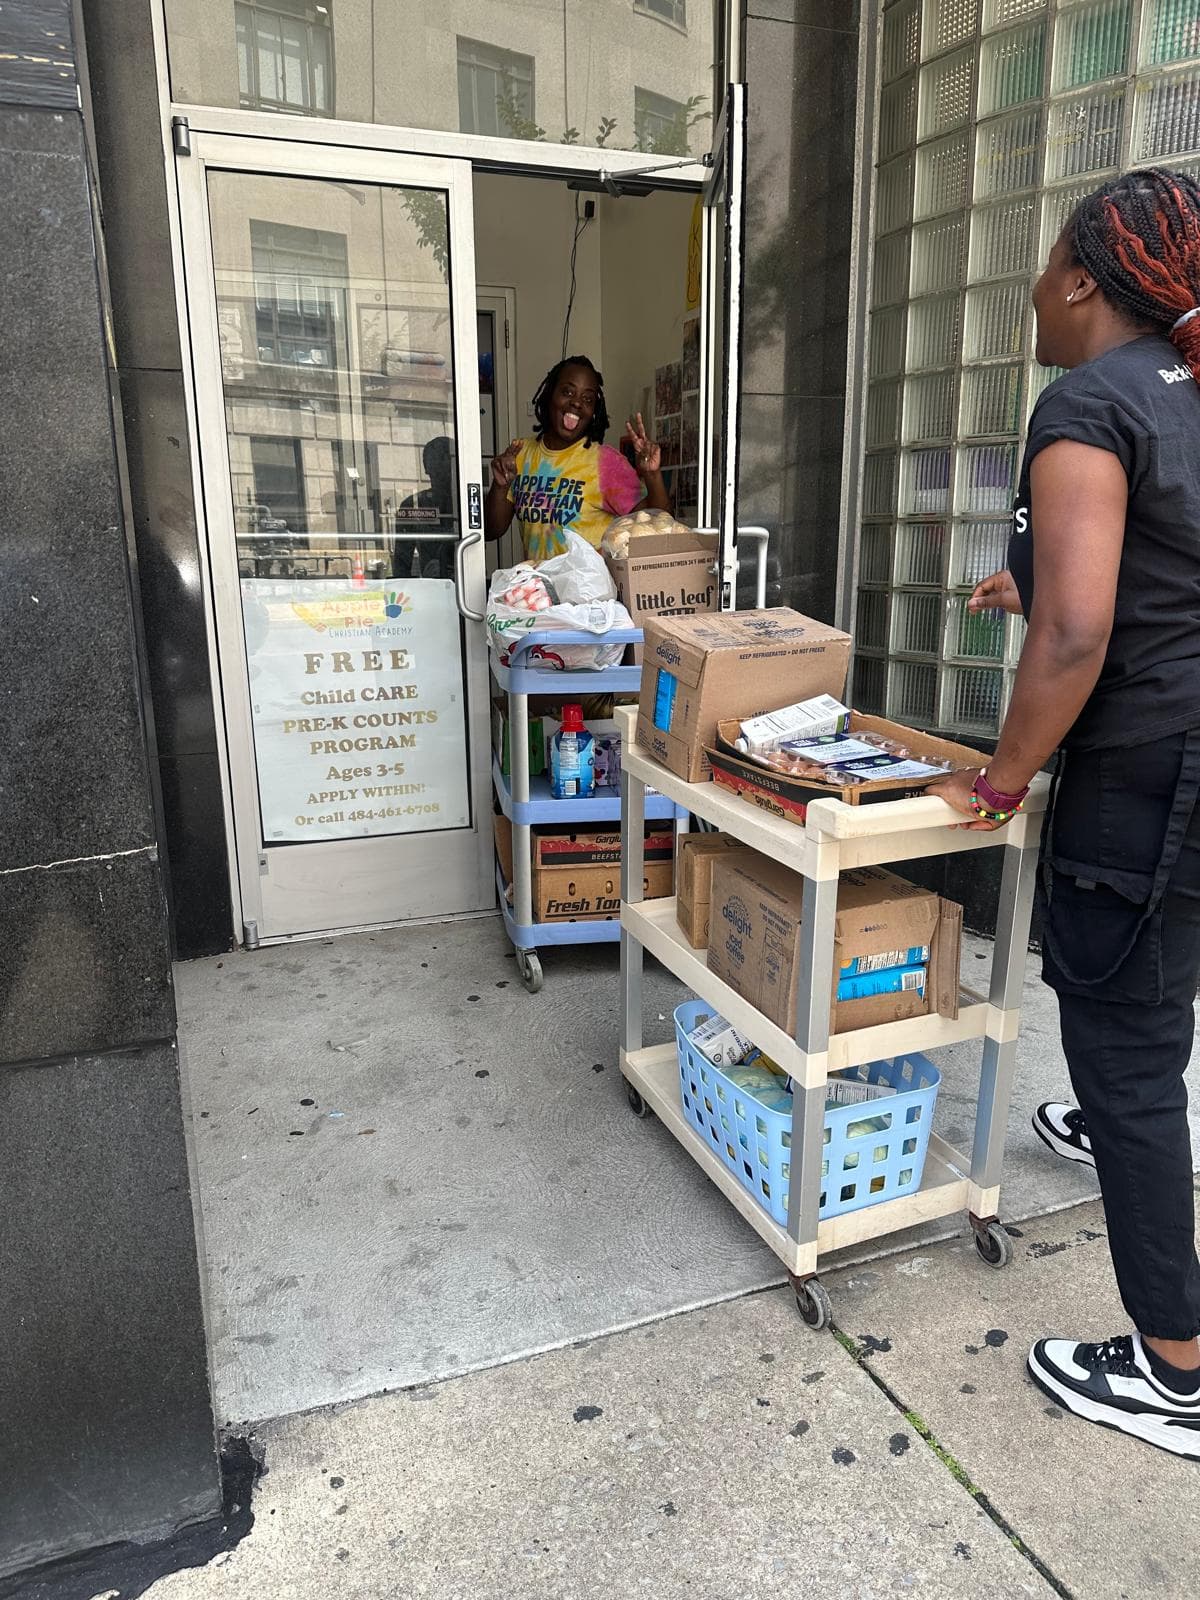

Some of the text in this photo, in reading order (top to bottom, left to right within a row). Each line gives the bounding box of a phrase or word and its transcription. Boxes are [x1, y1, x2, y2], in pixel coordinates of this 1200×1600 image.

[514, 474, 557, 492] APPLE
[470, 486, 479, 526] PULL
[516, 507, 577, 526] CADEMY
[636, 590, 675, 611] little
[680, 585, 715, 608] leaf
[304, 649, 410, 674] FREE
[301, 684, 419, 705] Child CARE
[283, 710, 438, 733] PRE-K COUNTS
[310, 734, 416, 754] PROGRAM
[326, 763, 405, 782] Ages 3-5
[306, 783, 426, 805] APPLY WITHIN!
[295, 802, 440, 826] Or call 484-461-6708
[547, 898, 590, 913] Fresh
[722, 903, 753, 939] delight
